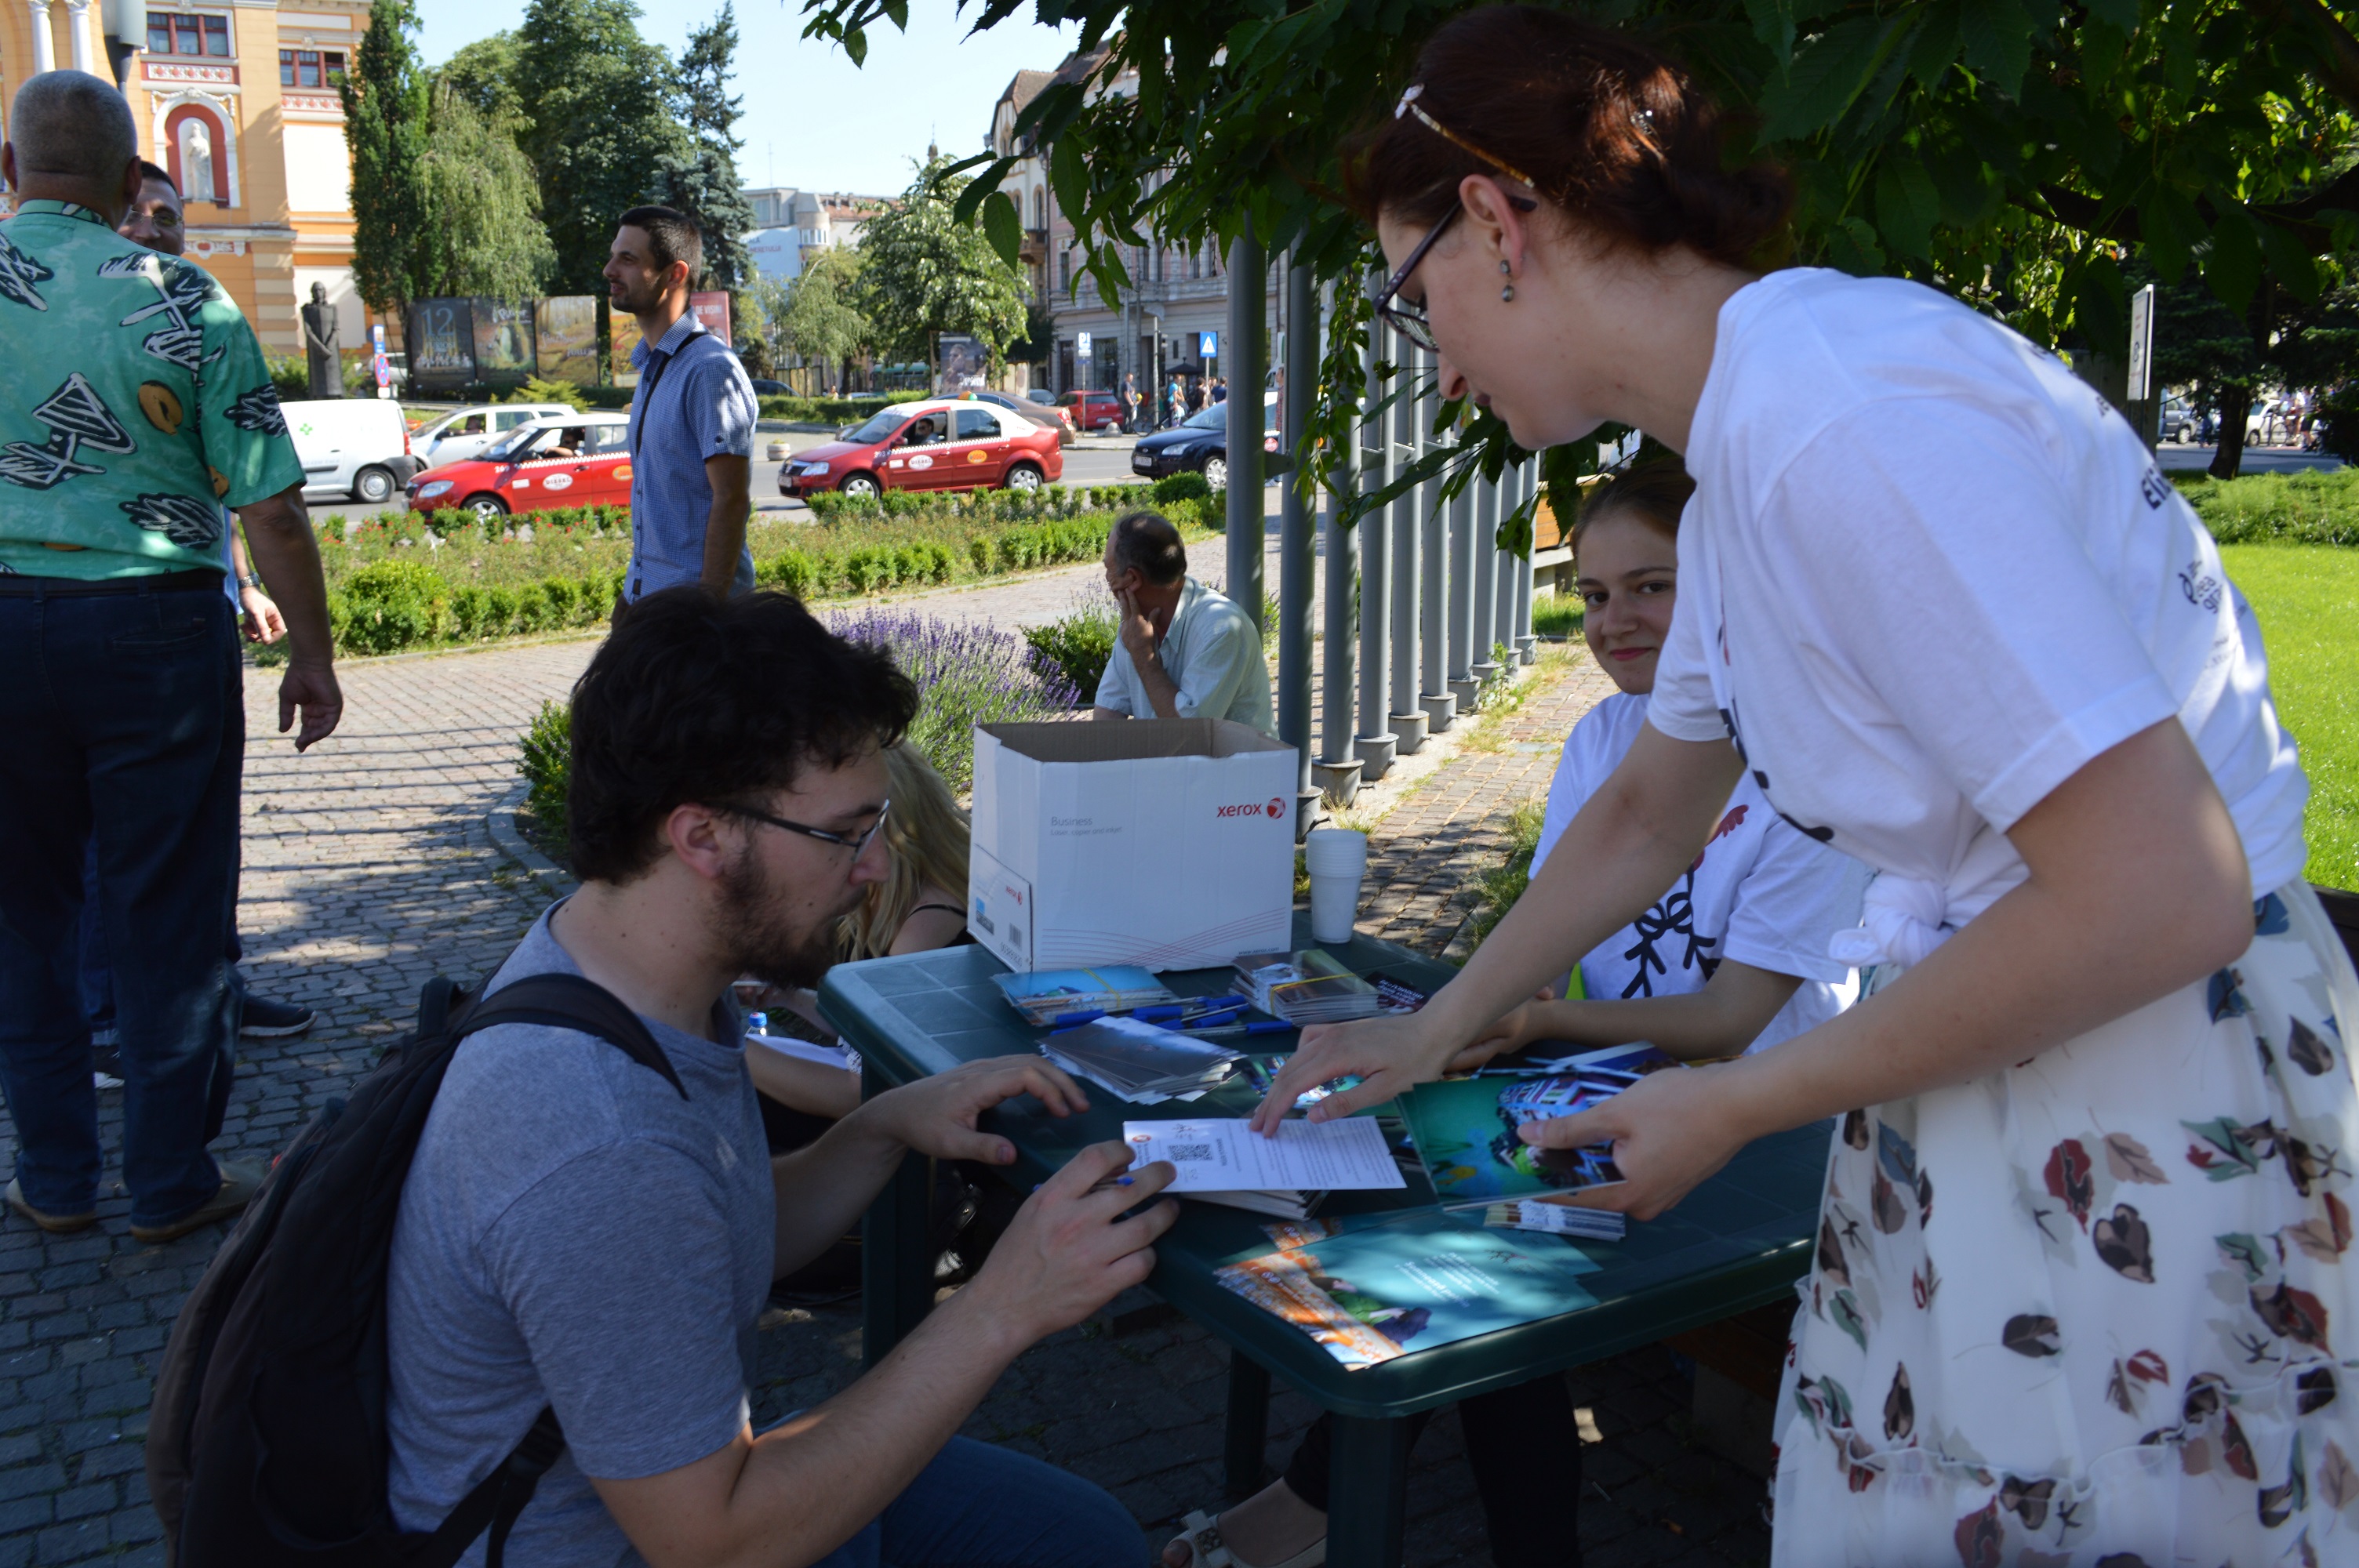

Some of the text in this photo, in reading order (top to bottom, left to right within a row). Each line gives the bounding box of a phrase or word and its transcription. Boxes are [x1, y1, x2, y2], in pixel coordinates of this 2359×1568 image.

[421, 307, 455, 336] 12
[1216, 803, 1262, 818] xerox
[1051, 815, 1092, 826] Business
